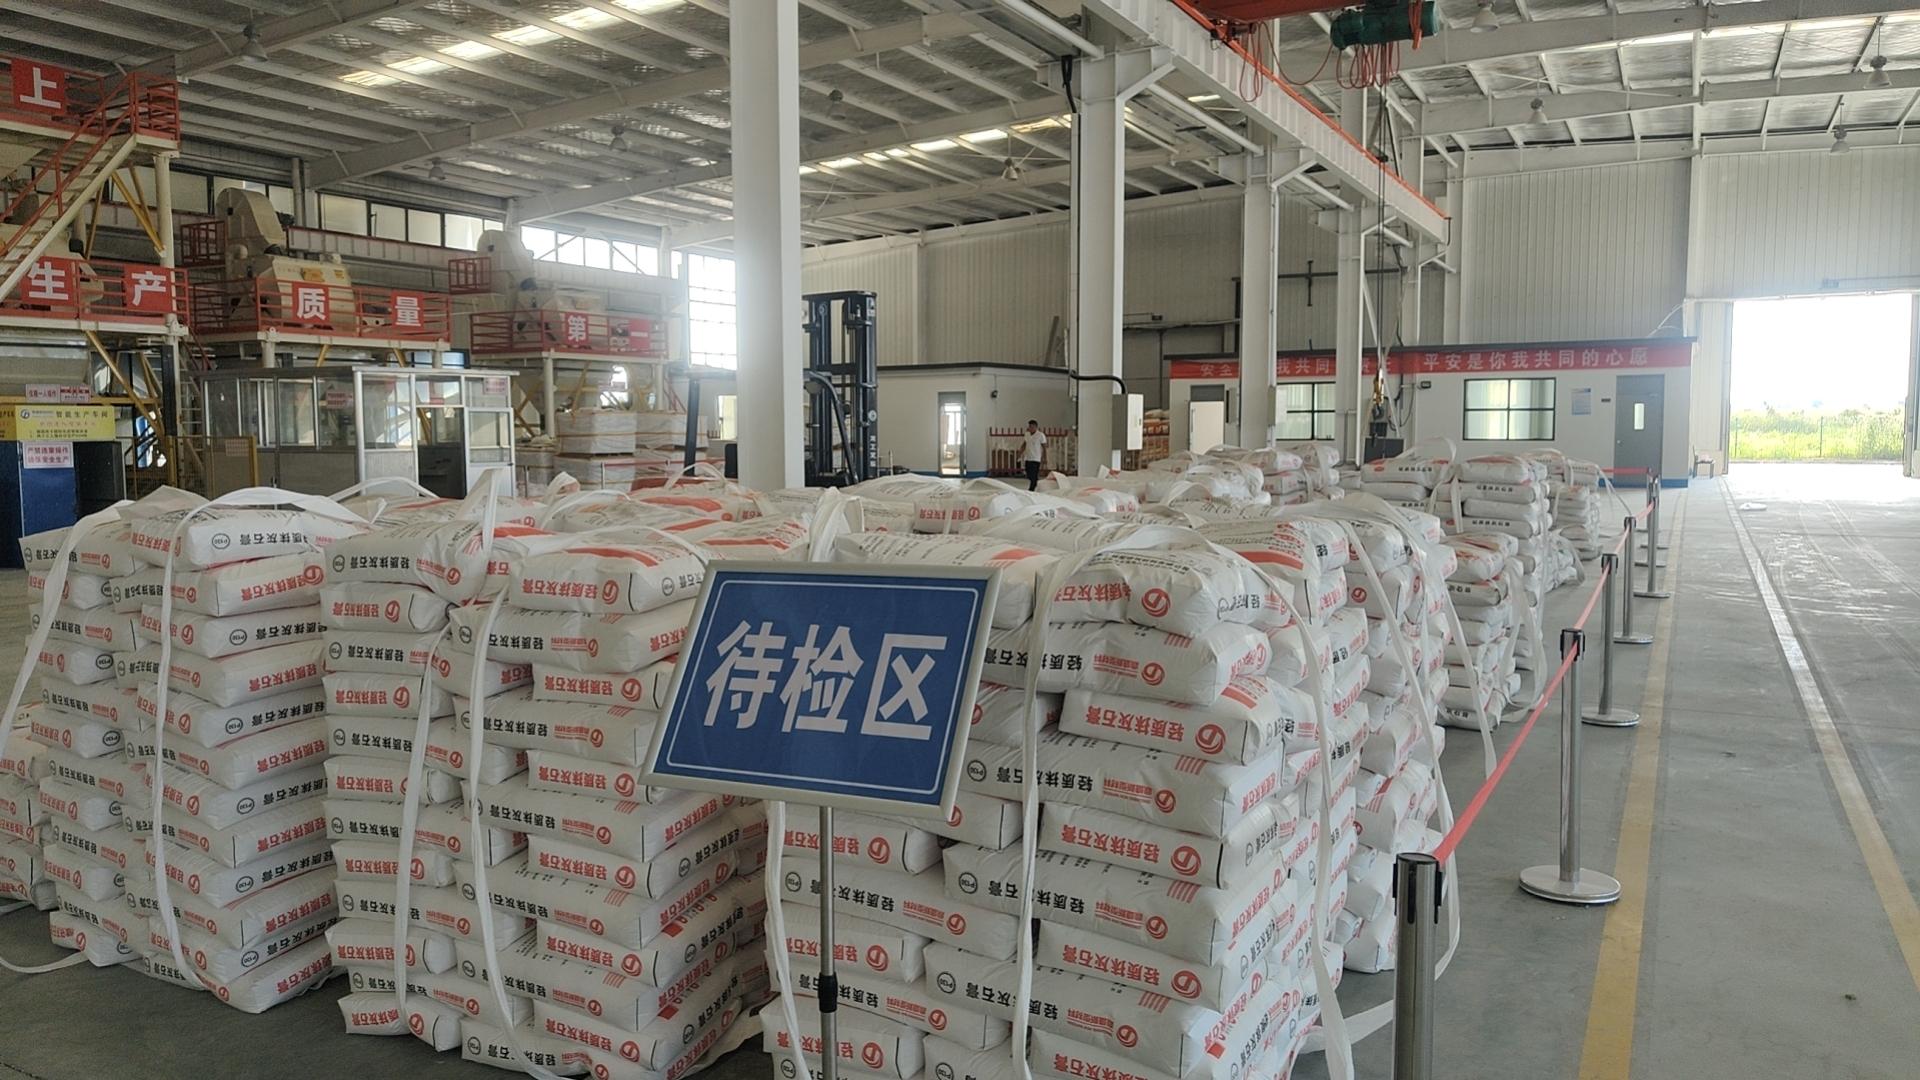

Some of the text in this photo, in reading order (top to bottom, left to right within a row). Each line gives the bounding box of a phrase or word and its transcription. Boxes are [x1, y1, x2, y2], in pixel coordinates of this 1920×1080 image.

[19, 67, 62, 110] 上
[27, 262, 167, 306] 生 产
[296, 287, 421, 327] 质 量
[567, 314, 588, 342] 第
[1424, 347, 1648, 371] 平安是你我共同的心愿
[240, 532, 308, 547] 质抹灰石膏
[350, 555, 410, 570] 轻质抹灰石膏
[523, 579, 598, 598] 轻质抹灰石膏
[488, 633, 544, 650] 轻质抹灰石
[984, 648, 1082, 671] 轻质灰石膏
[249, 664, 317, 692] 轻质抹灰石膏
[545, 676, 614, 695] 轻质抹灰石膏
[704, 620, 947, 740] 待检区
[252, 701, 325, 727] 轻质抹灰石膏
[1086, 705, 1184, 742] 轻质抹灰石膏
[257, 739, 326, 773] 轻质抹灰石膏
[263, 778, 327, 806] 质抹灰石膏
[336, 775, 394, 793] 轻质抹灰石膏
[538, 766, 606, 791] 轻质抹灰石膏
[997, 766, 1094, 794] 轻质抹石膏
[349, 821, 401, 838] 质抹灰石膏
[490, 804, 556, 830] 轻质抹灰石膏
[257, 816, 326, 853] 轻质抹灰石膏
[784, 829, 860, 855] 轻质灰石膏
[1061, 824, 1160, 864] 轻质抹灰石膏
[539, 852, 607, 880] 轻质抹灰石膏
[489, 893, 548, 918] 轻质抹灰石
[810, 880, 894, 913] 轻质抹灰膏
[989, 880, 1085, 915] 轻质抹石膏
[265, 893, 331, 934] 轻质抹灰石膏
[547, 936, 613, 967] 轻质抹灰石膏
[1062, 945, 1160, 986] 轻质抹灰石膏
[277, 953, 332, 994] 质抹灰石膏
[799, 973, 879, 1009] 轻质抹石膏
[966, 982, 1058, 1020] 轻质灰石膏
[352, 1008, 399, 1027] 质抹灰石膏
[546, 1018, 612, 1052] 轻质抹灰石膏
